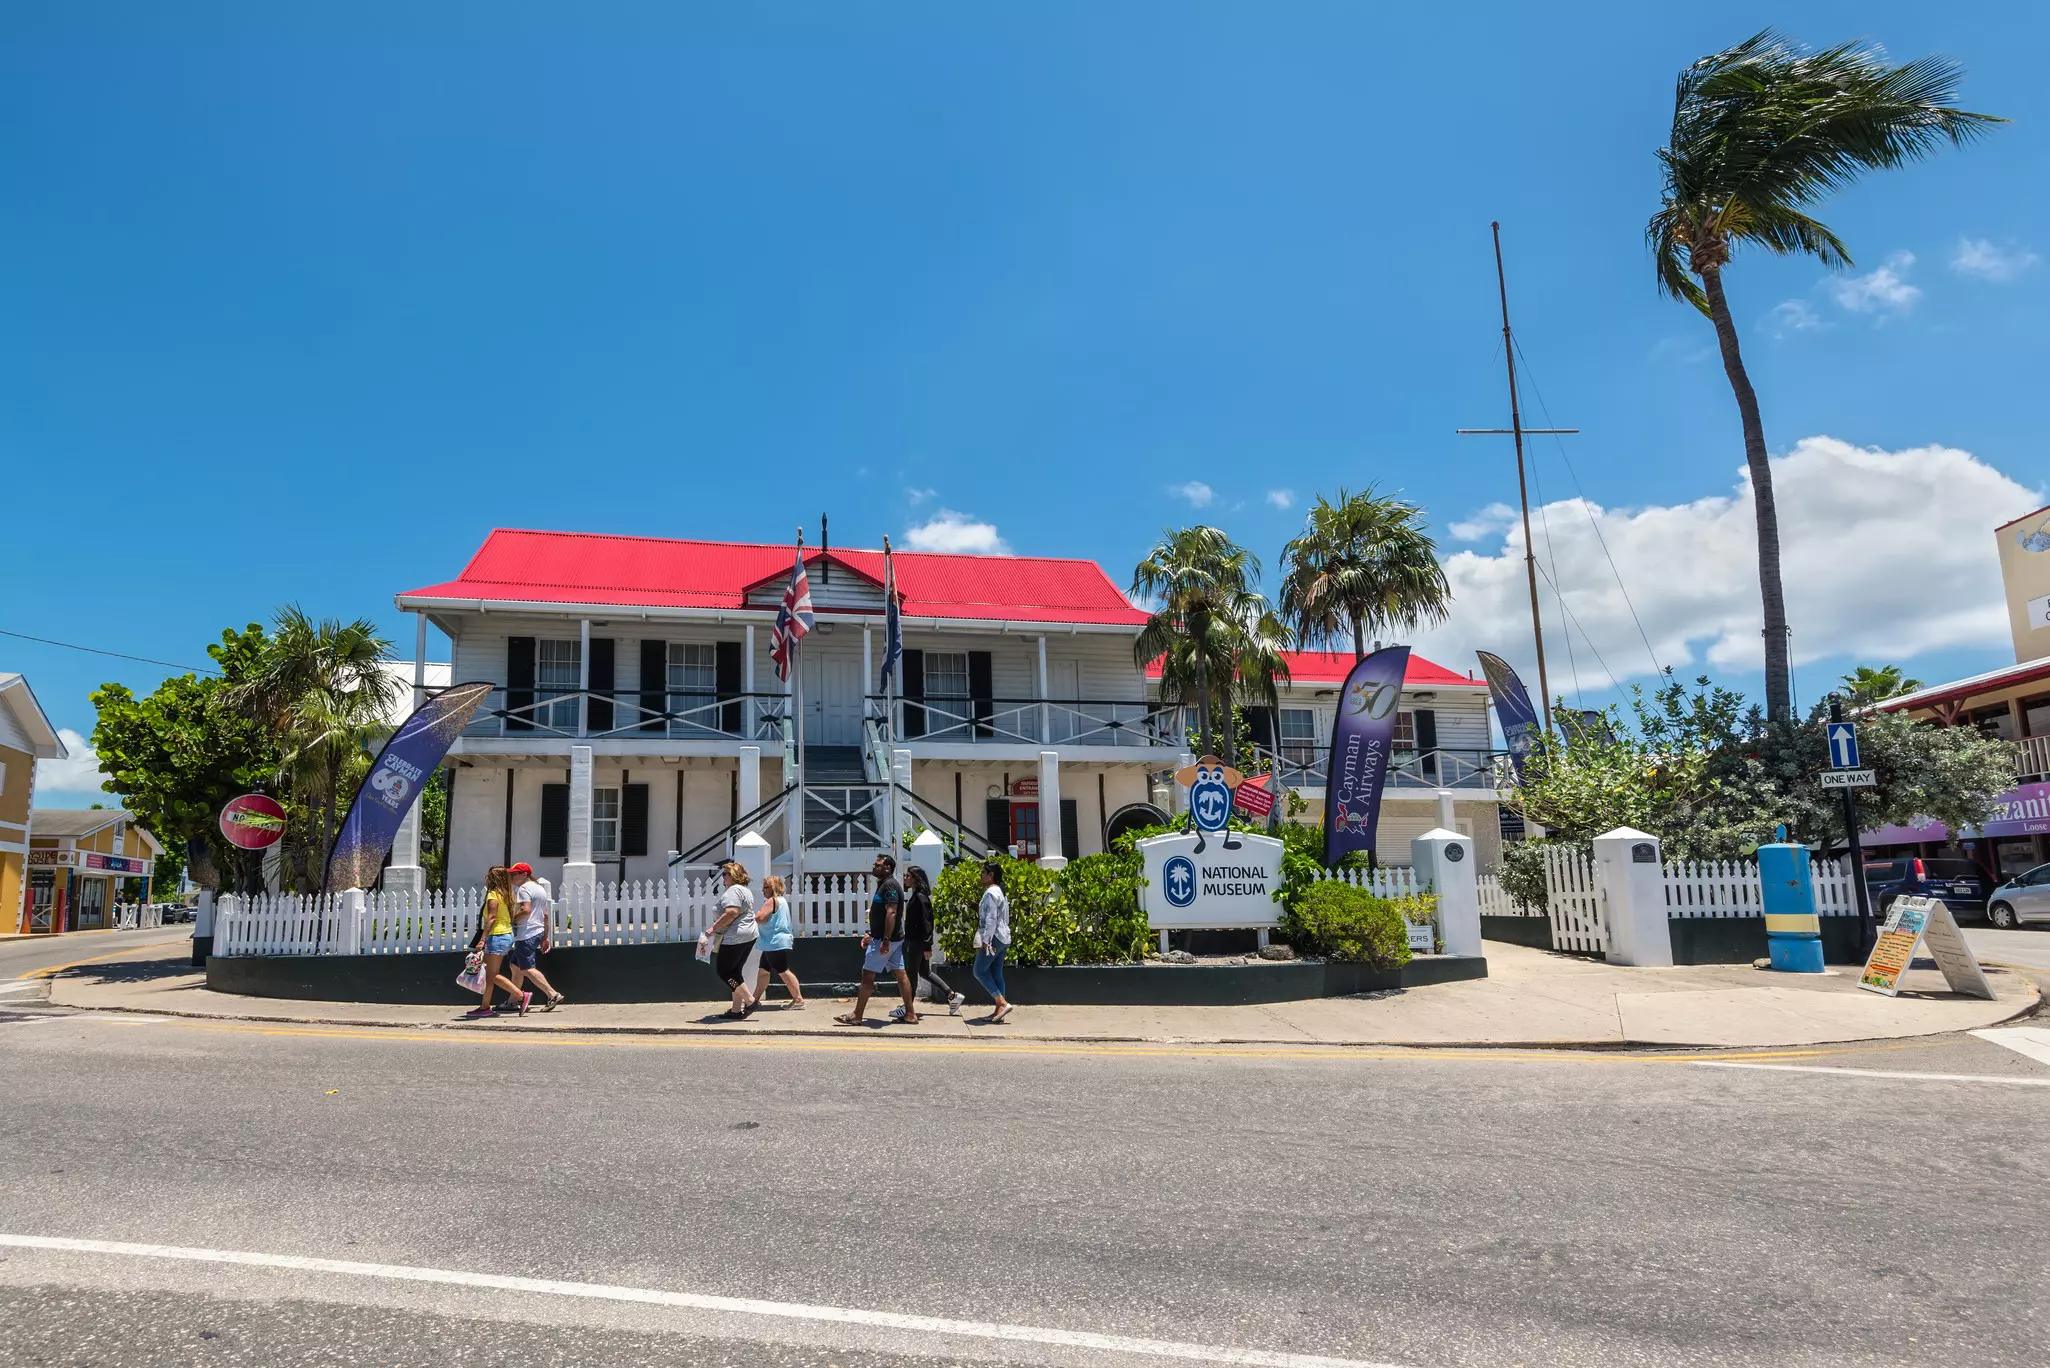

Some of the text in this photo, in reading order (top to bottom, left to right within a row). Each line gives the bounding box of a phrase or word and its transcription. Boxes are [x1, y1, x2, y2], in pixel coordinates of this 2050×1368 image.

[1344, 681, 1398, 720] 50
[384, 758, 420, 782] CAYMAN
[388, 753, 423, 776] CELEBRATE
[1338, 734, 1361, 803] Cayman
[1355, 739, 1382, 806] Airways
[371, 768, 408, 800] 60
[1824, 773, 1870, 784] ONE WAY
[381, 794, 399, 809] YEARS
[1989, 789, 2050, 821] zani
[2023, 823, 2047, 832] Loose
[1202, 866, 1268, 879] NATIONAL
[1203, 883, 1266, 896] MUSEUM
